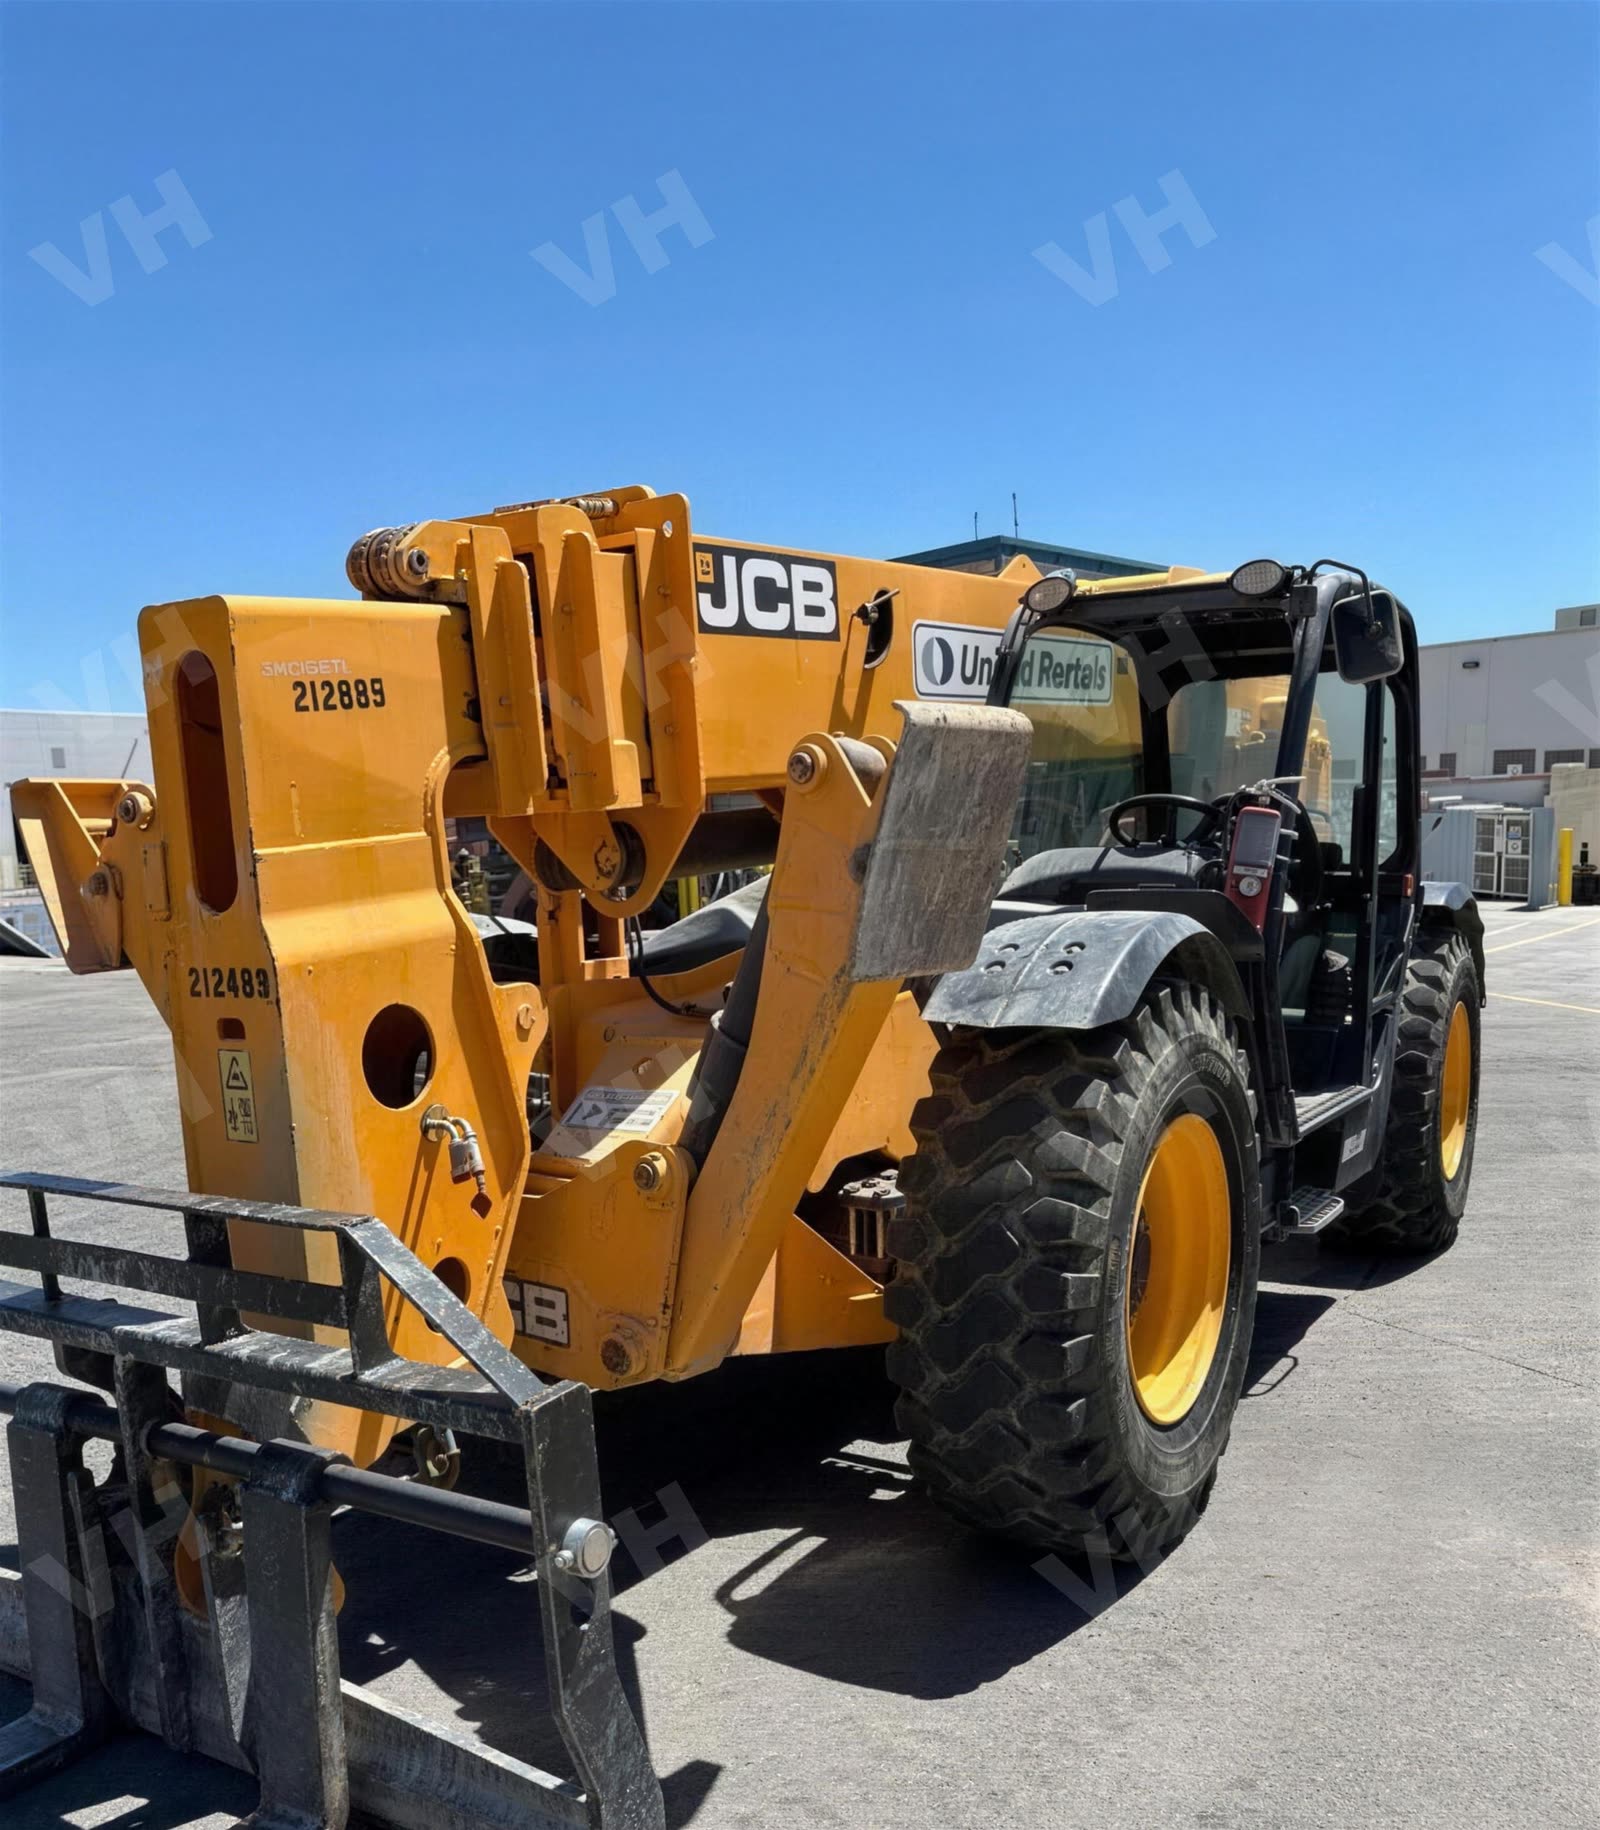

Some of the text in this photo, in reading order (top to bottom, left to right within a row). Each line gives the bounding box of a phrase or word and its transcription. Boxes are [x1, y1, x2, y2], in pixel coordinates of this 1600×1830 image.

[698, 555, 836, 633] JCB
[961, 644, 1036, 687] Und
[292, 678, 386, 712] 212889
